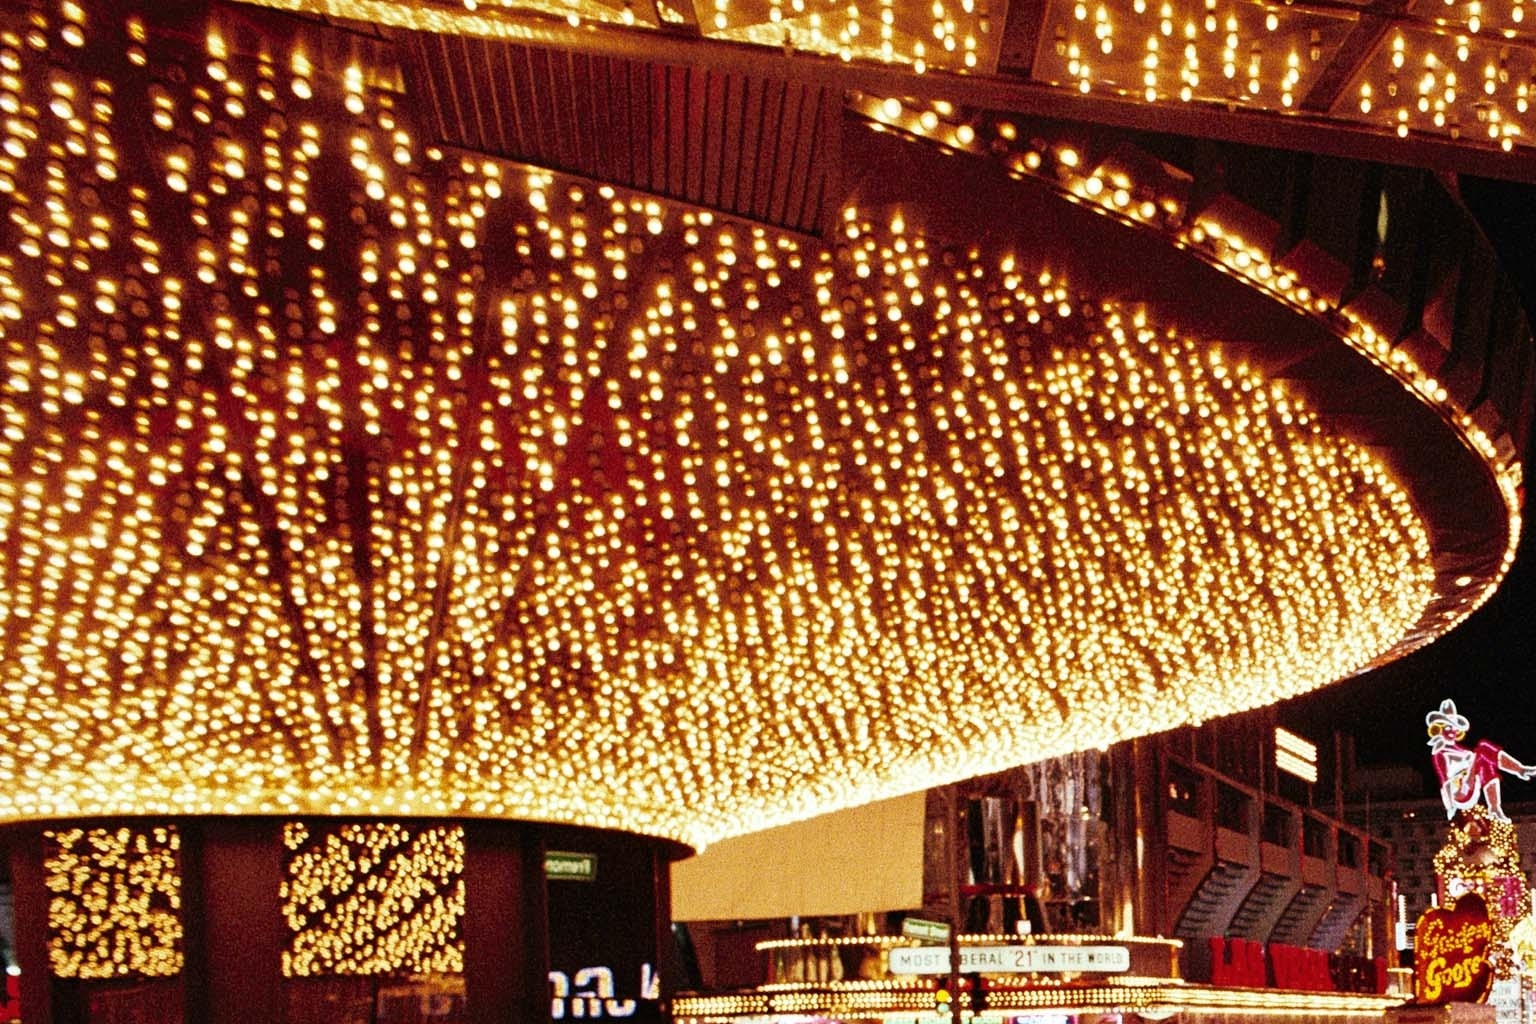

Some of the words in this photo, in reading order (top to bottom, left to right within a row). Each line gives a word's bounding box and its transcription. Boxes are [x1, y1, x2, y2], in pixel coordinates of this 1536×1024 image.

[900, 954, 940, 967] MOST
[1043, 953, 1055, 965] IN
[1061, 953, 1081, 965] THE
[1088, 953, 1122, 965] WORLD
[1424, 957, 1482, 1000] Goose
